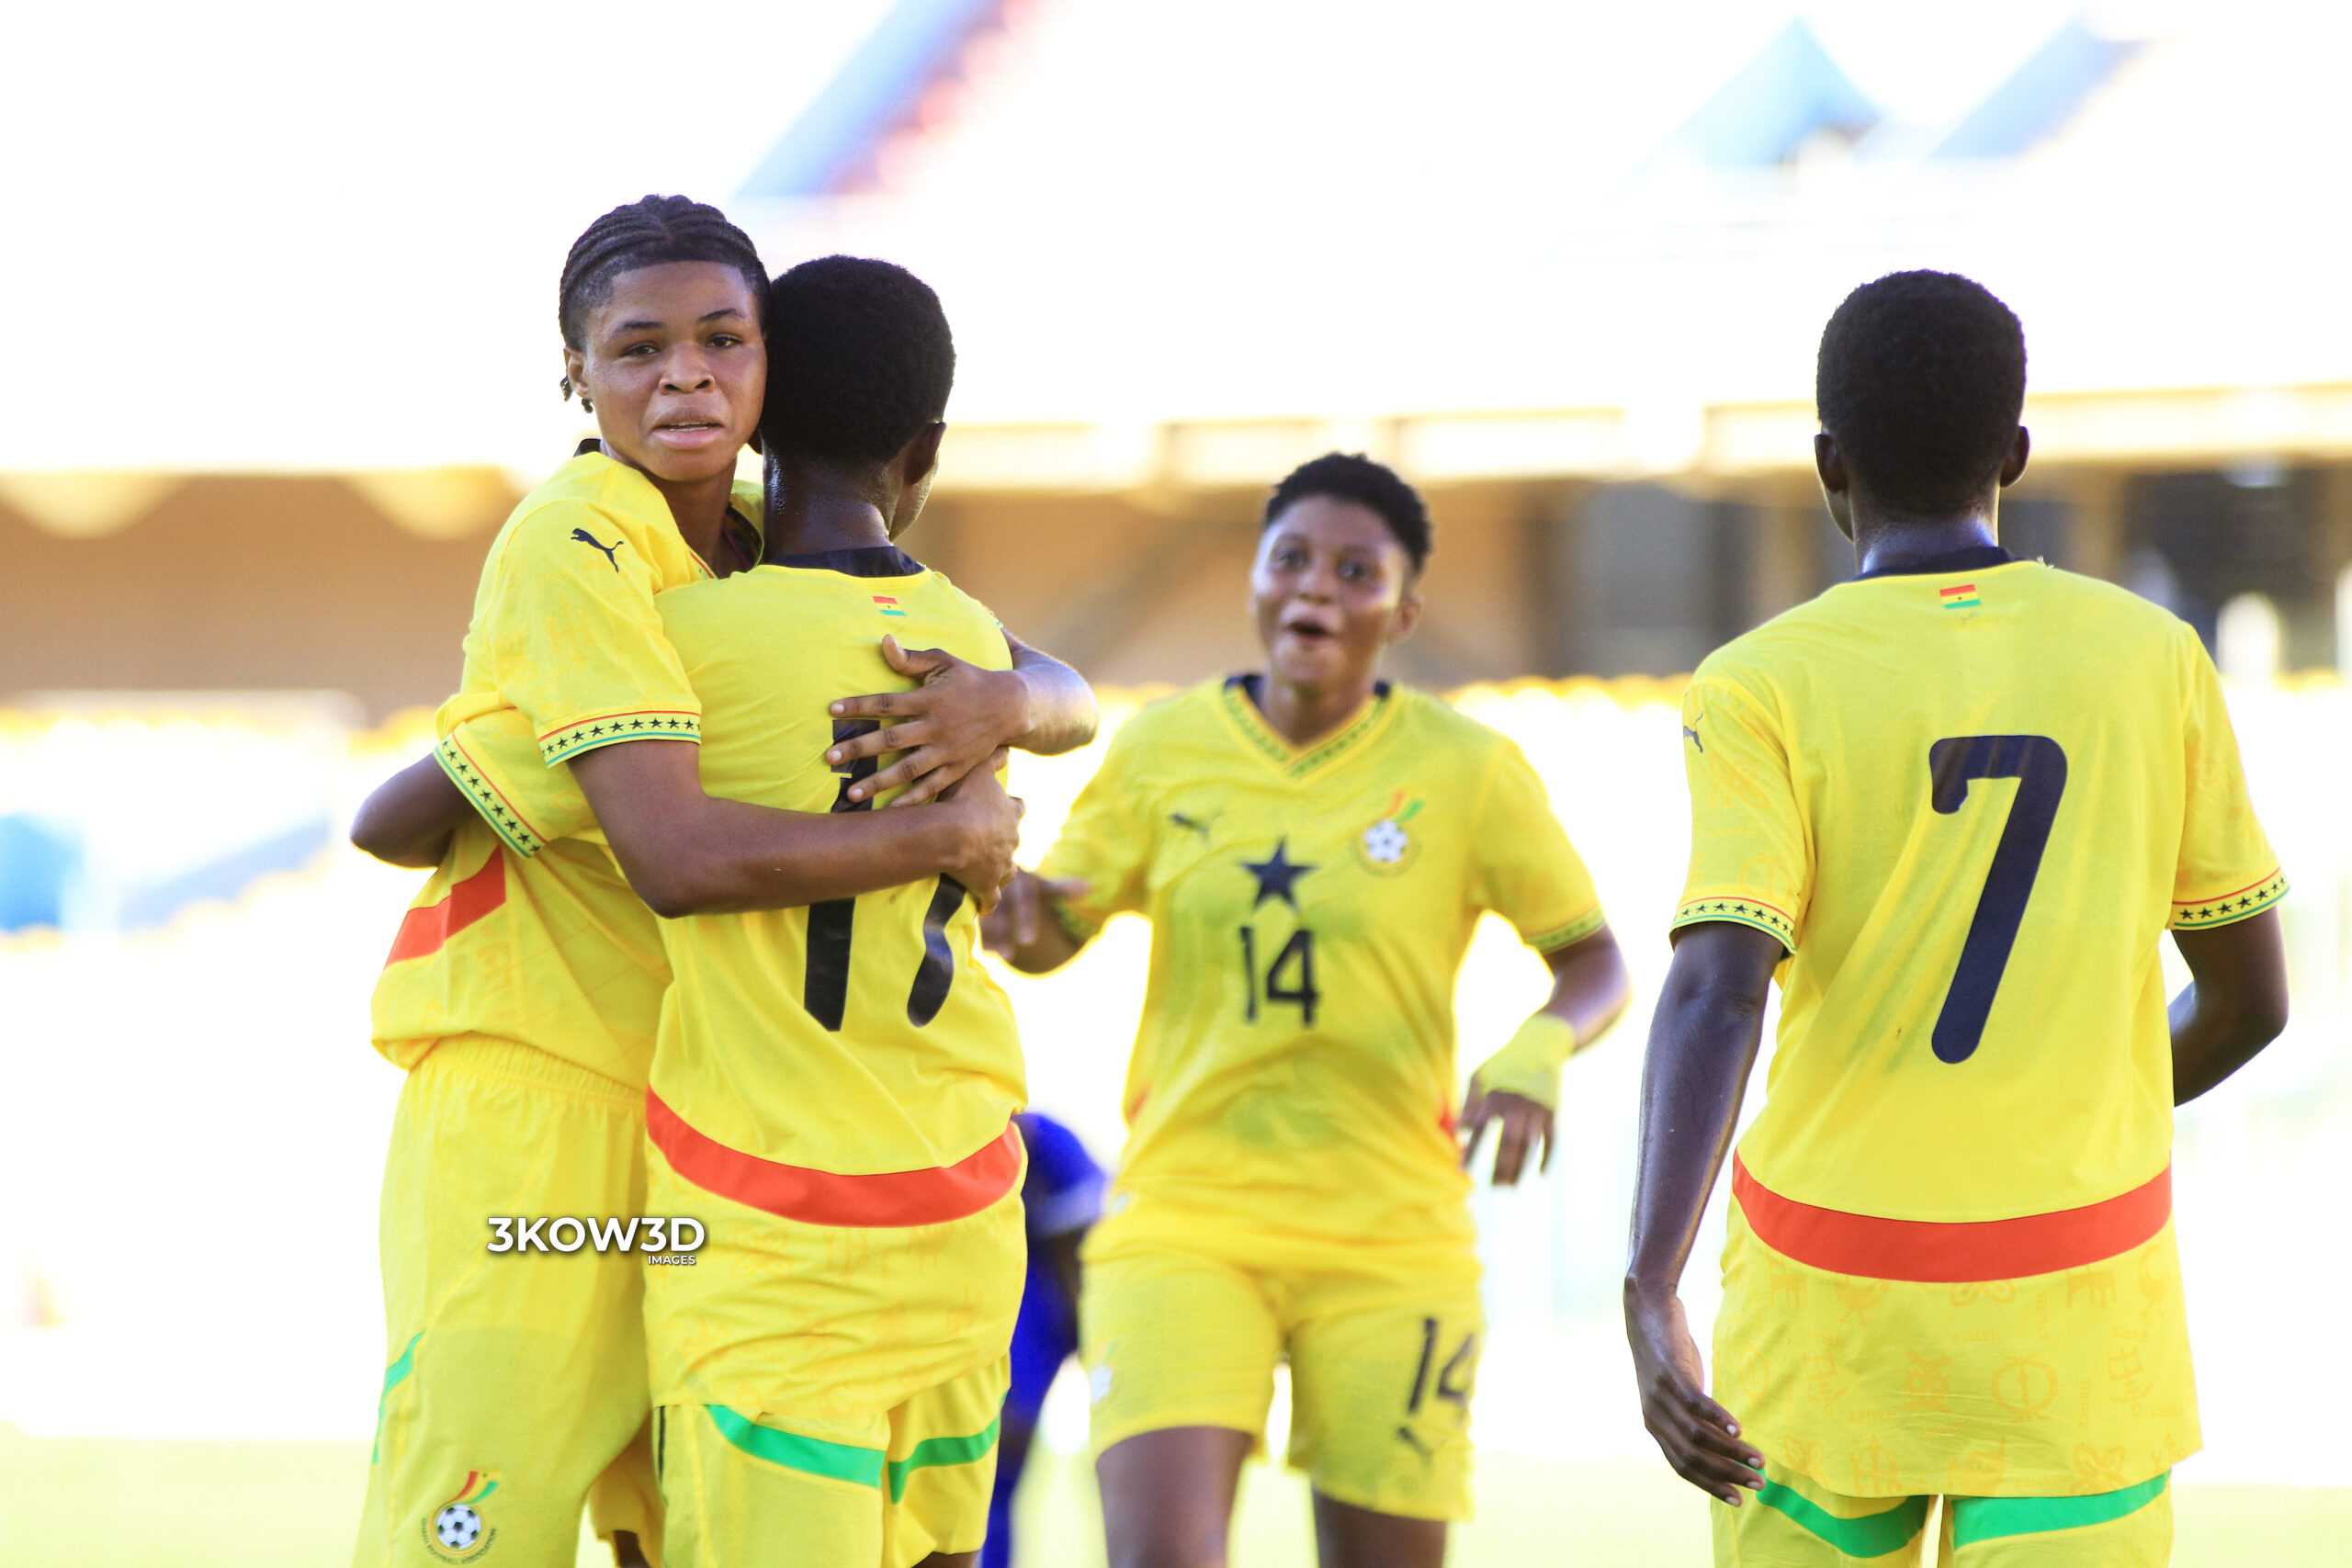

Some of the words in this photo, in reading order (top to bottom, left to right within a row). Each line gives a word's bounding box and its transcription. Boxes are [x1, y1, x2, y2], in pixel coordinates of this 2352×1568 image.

[1929, 735, 2067, 1064] 7
[1239, 926, 1320, 1029] 14
[1408, 1317, 1476, 1427] 14
